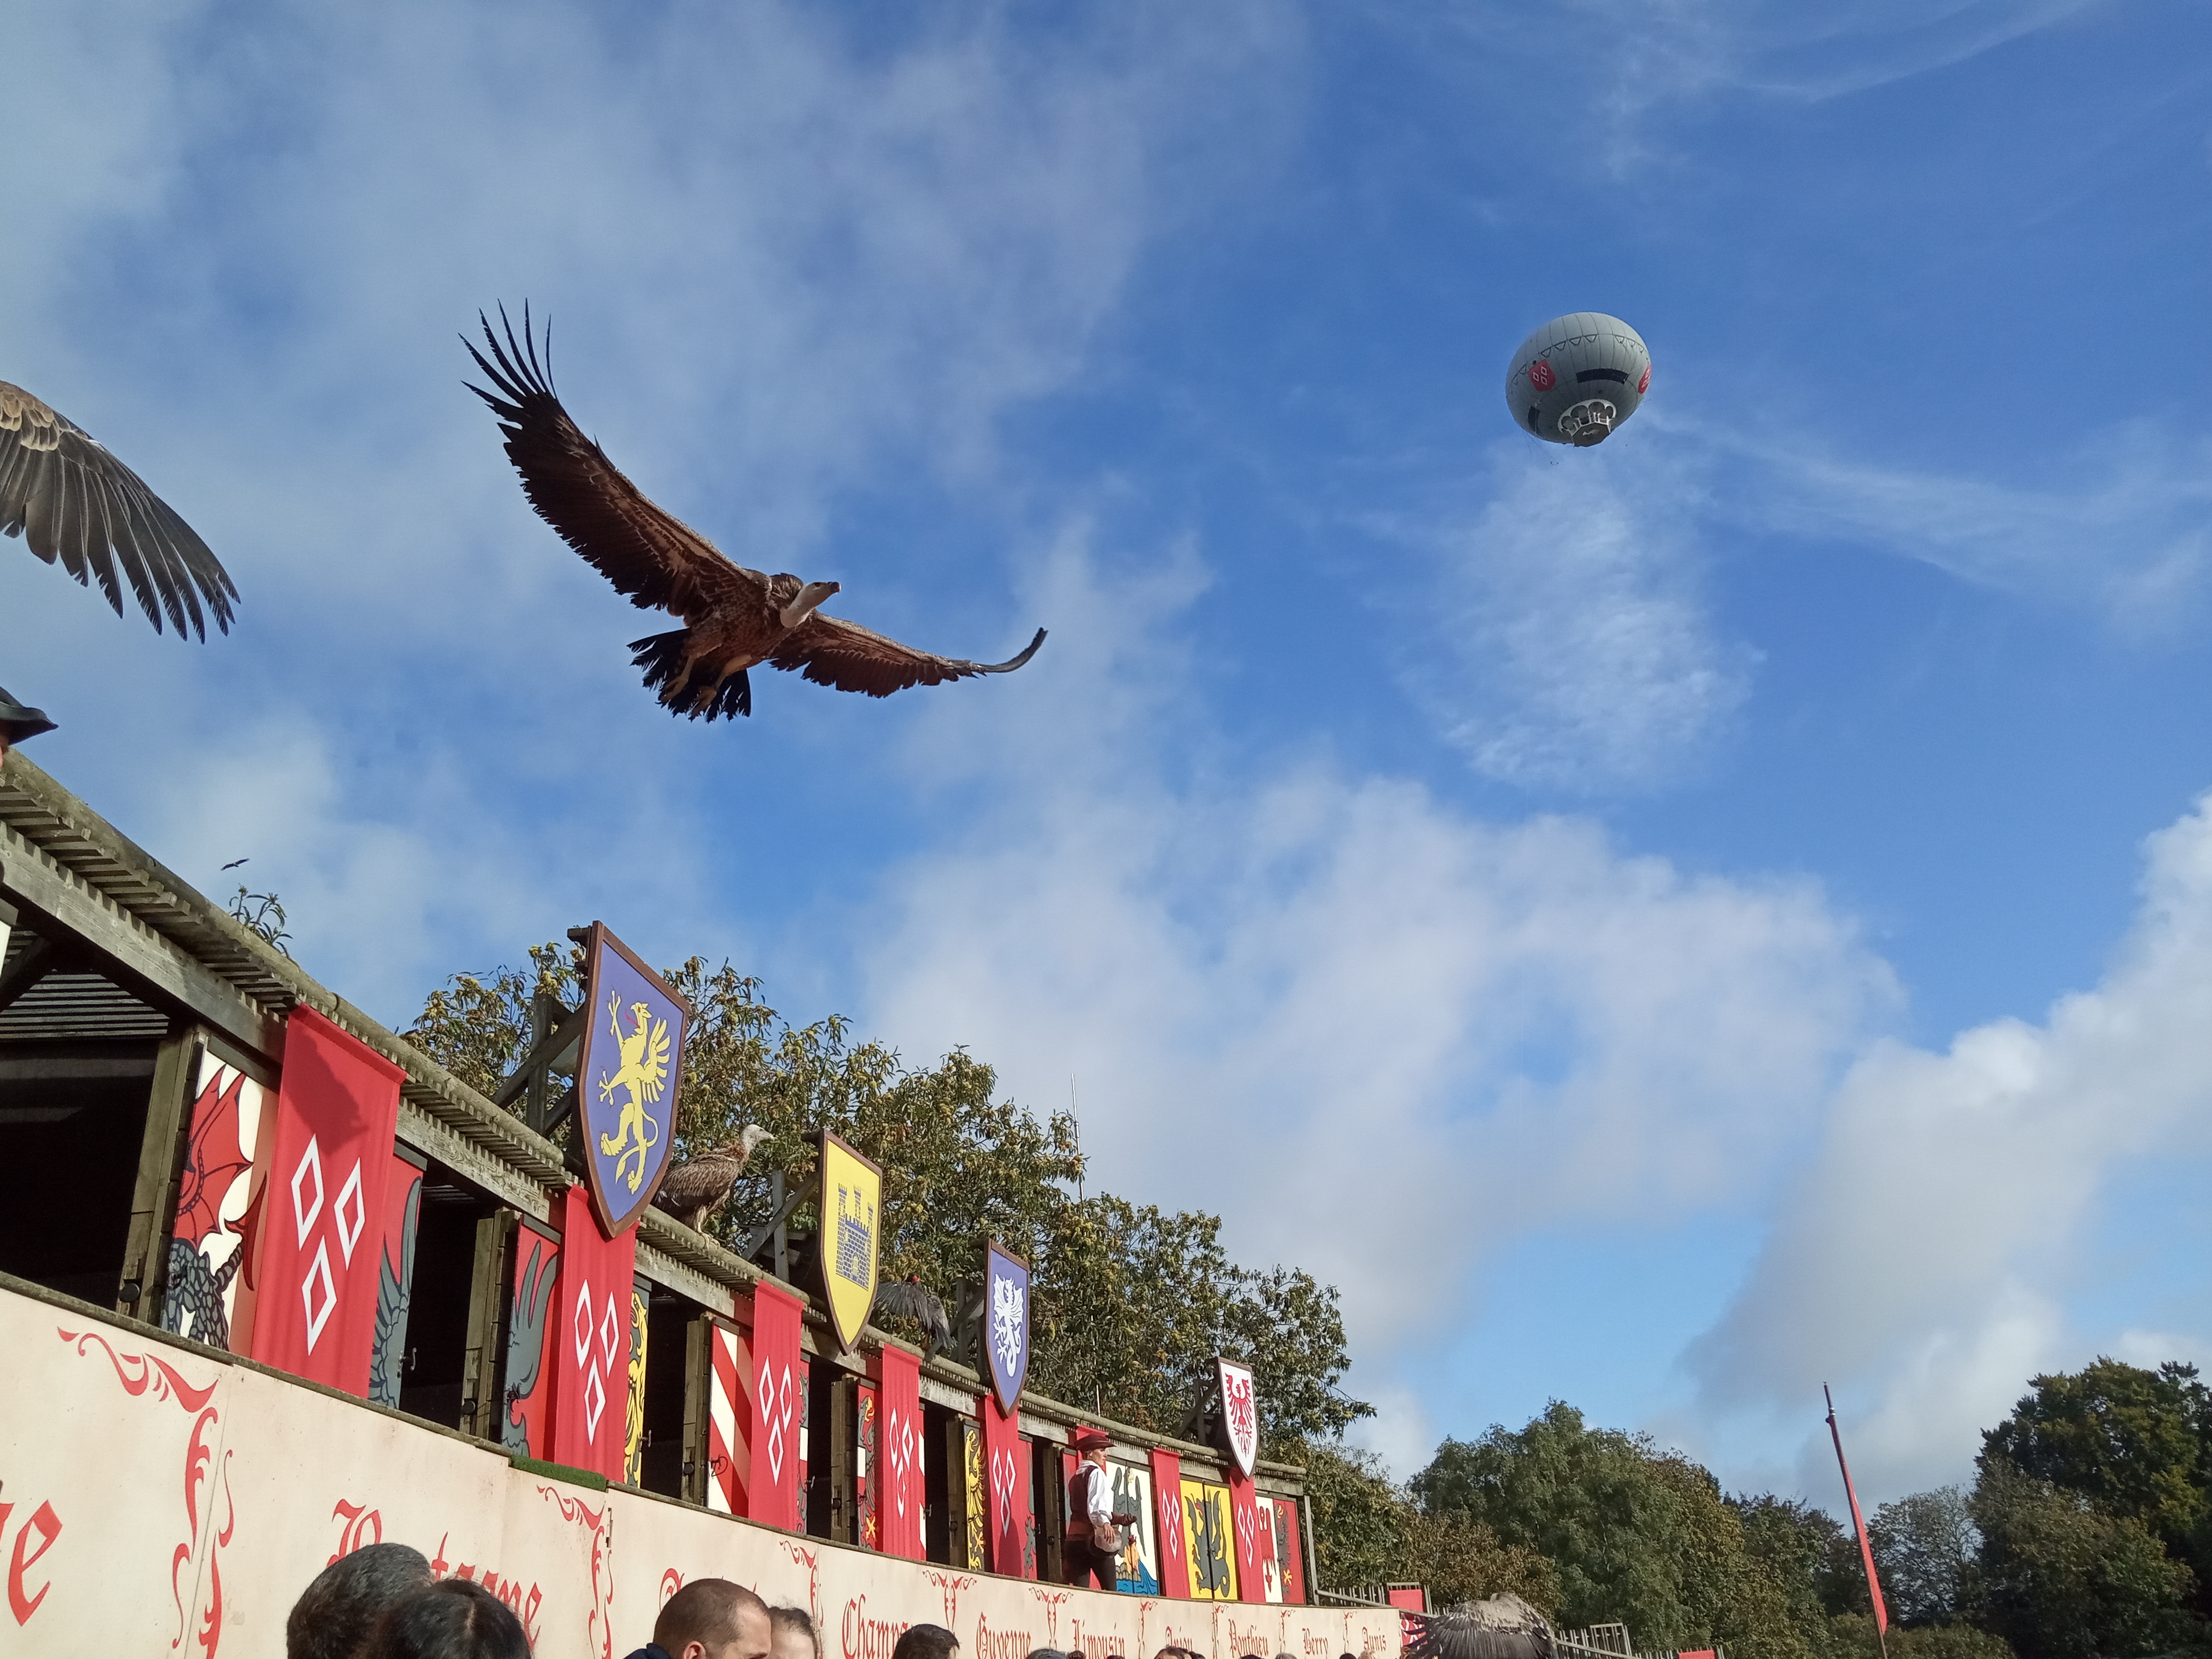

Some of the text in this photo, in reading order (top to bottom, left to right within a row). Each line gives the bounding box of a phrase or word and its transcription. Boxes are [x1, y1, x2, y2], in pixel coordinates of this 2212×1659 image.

[1228, 1619, 1269, 1658] Ponthieu
[1302, 1628, 1328, 1659] Berry
[1362, 1627, 1387, 1652] Aunis
